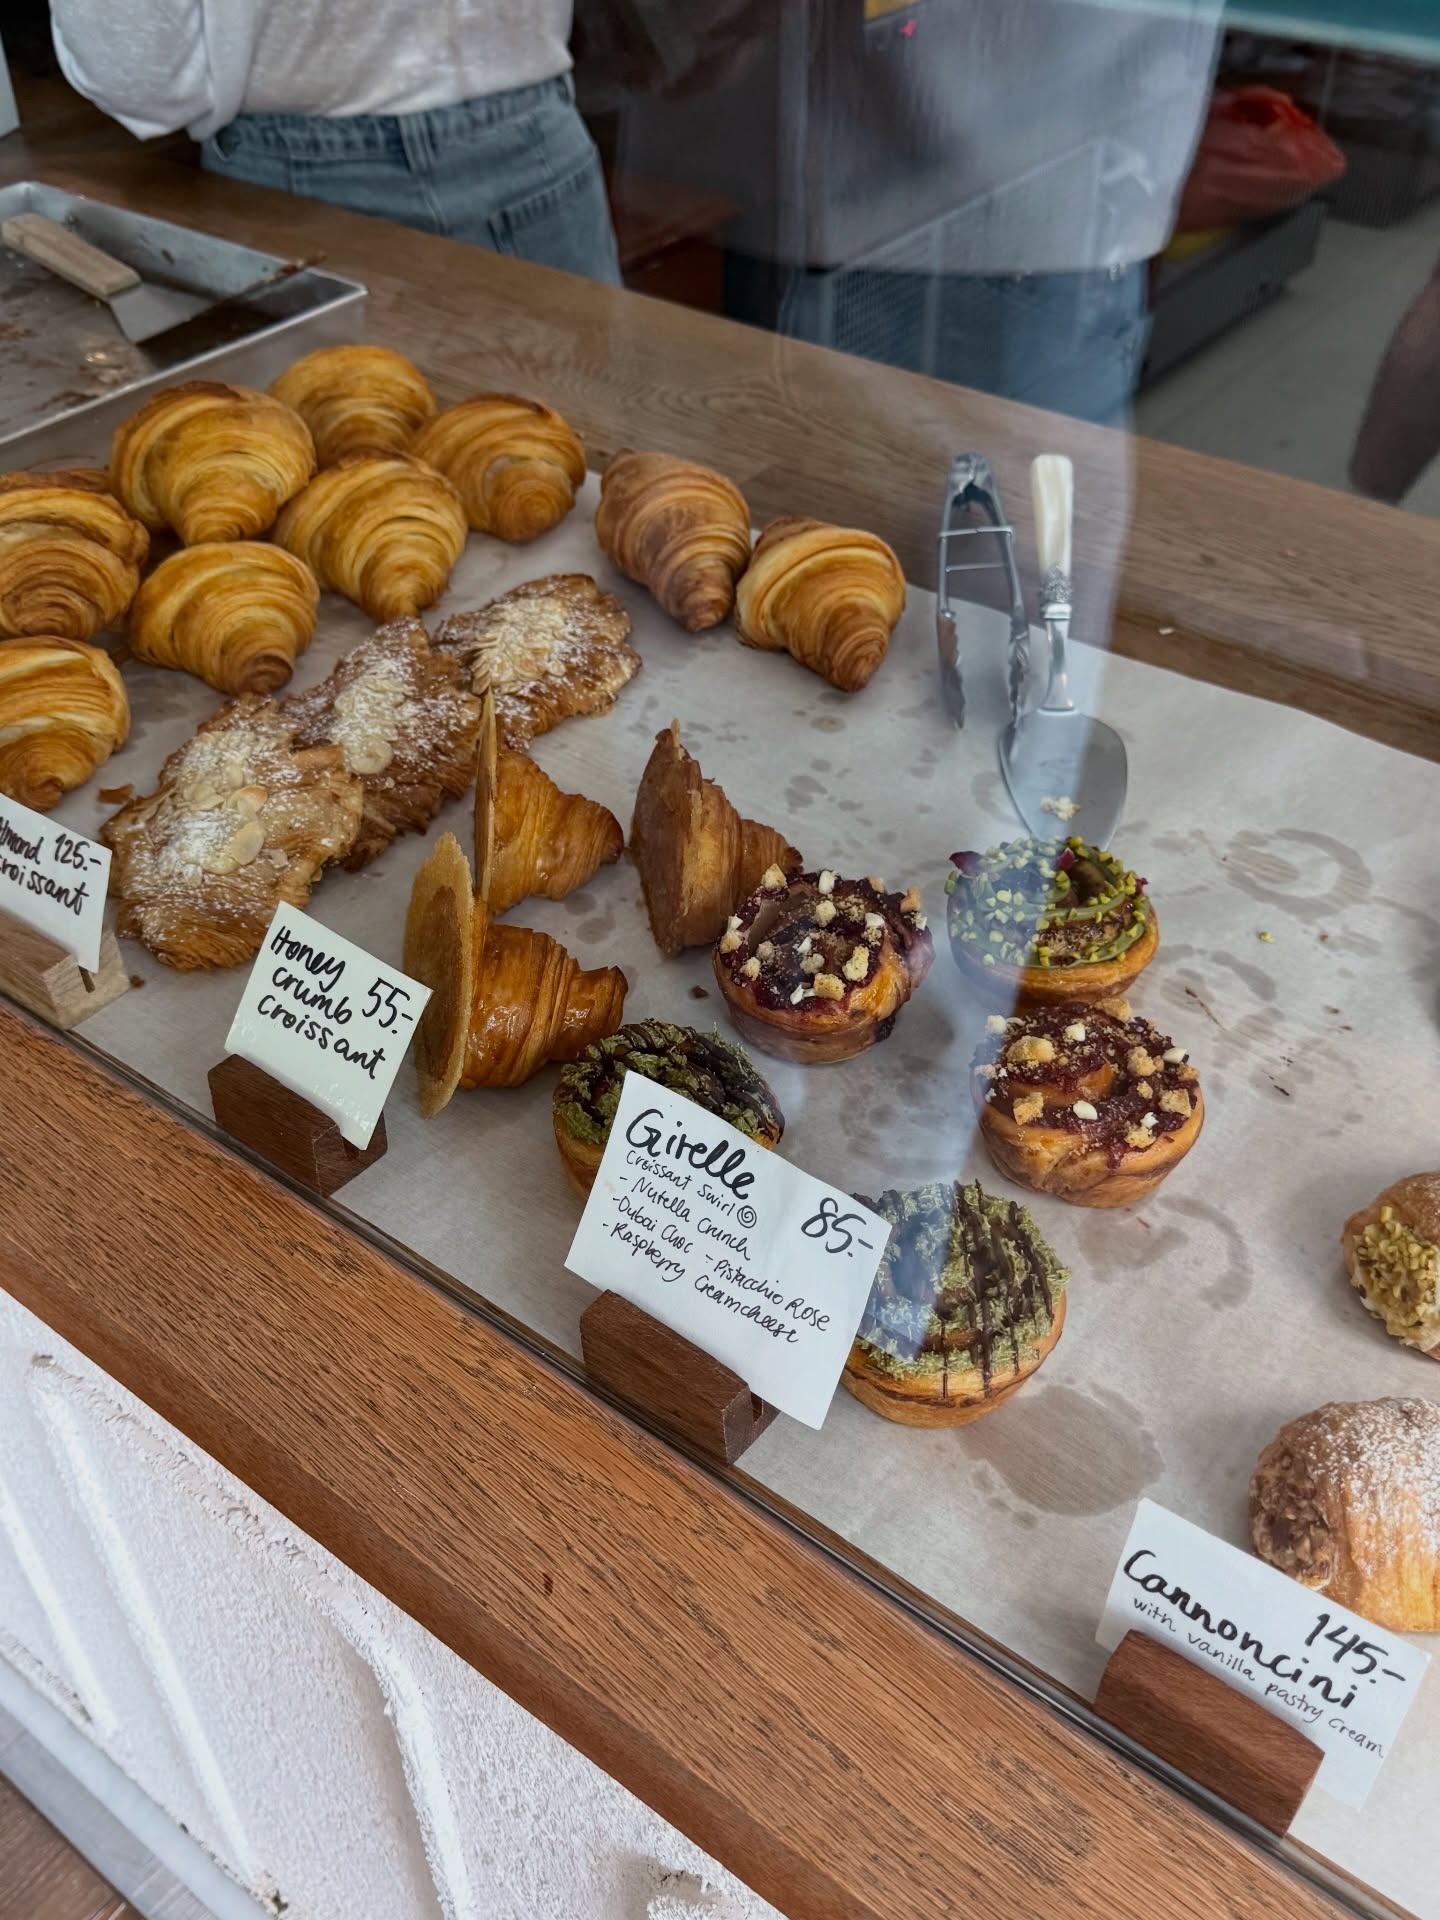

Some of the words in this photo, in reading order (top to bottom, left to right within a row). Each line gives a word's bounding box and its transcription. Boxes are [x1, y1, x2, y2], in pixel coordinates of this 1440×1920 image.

[0, 853, 90, 916] roissant
[270, 925, 346, 993] Honey
[626, 1108, 755, 1200] Girelle
[785, 1298, 831, 1332] Rose
[1123, 1549, 1358, 1709] Cannoncini
[1133, 1598, 1176, 1632] with
[1187, 1632, 1256, 1682] vanilla
[1264, 1682, 1323, 1723] pastry
